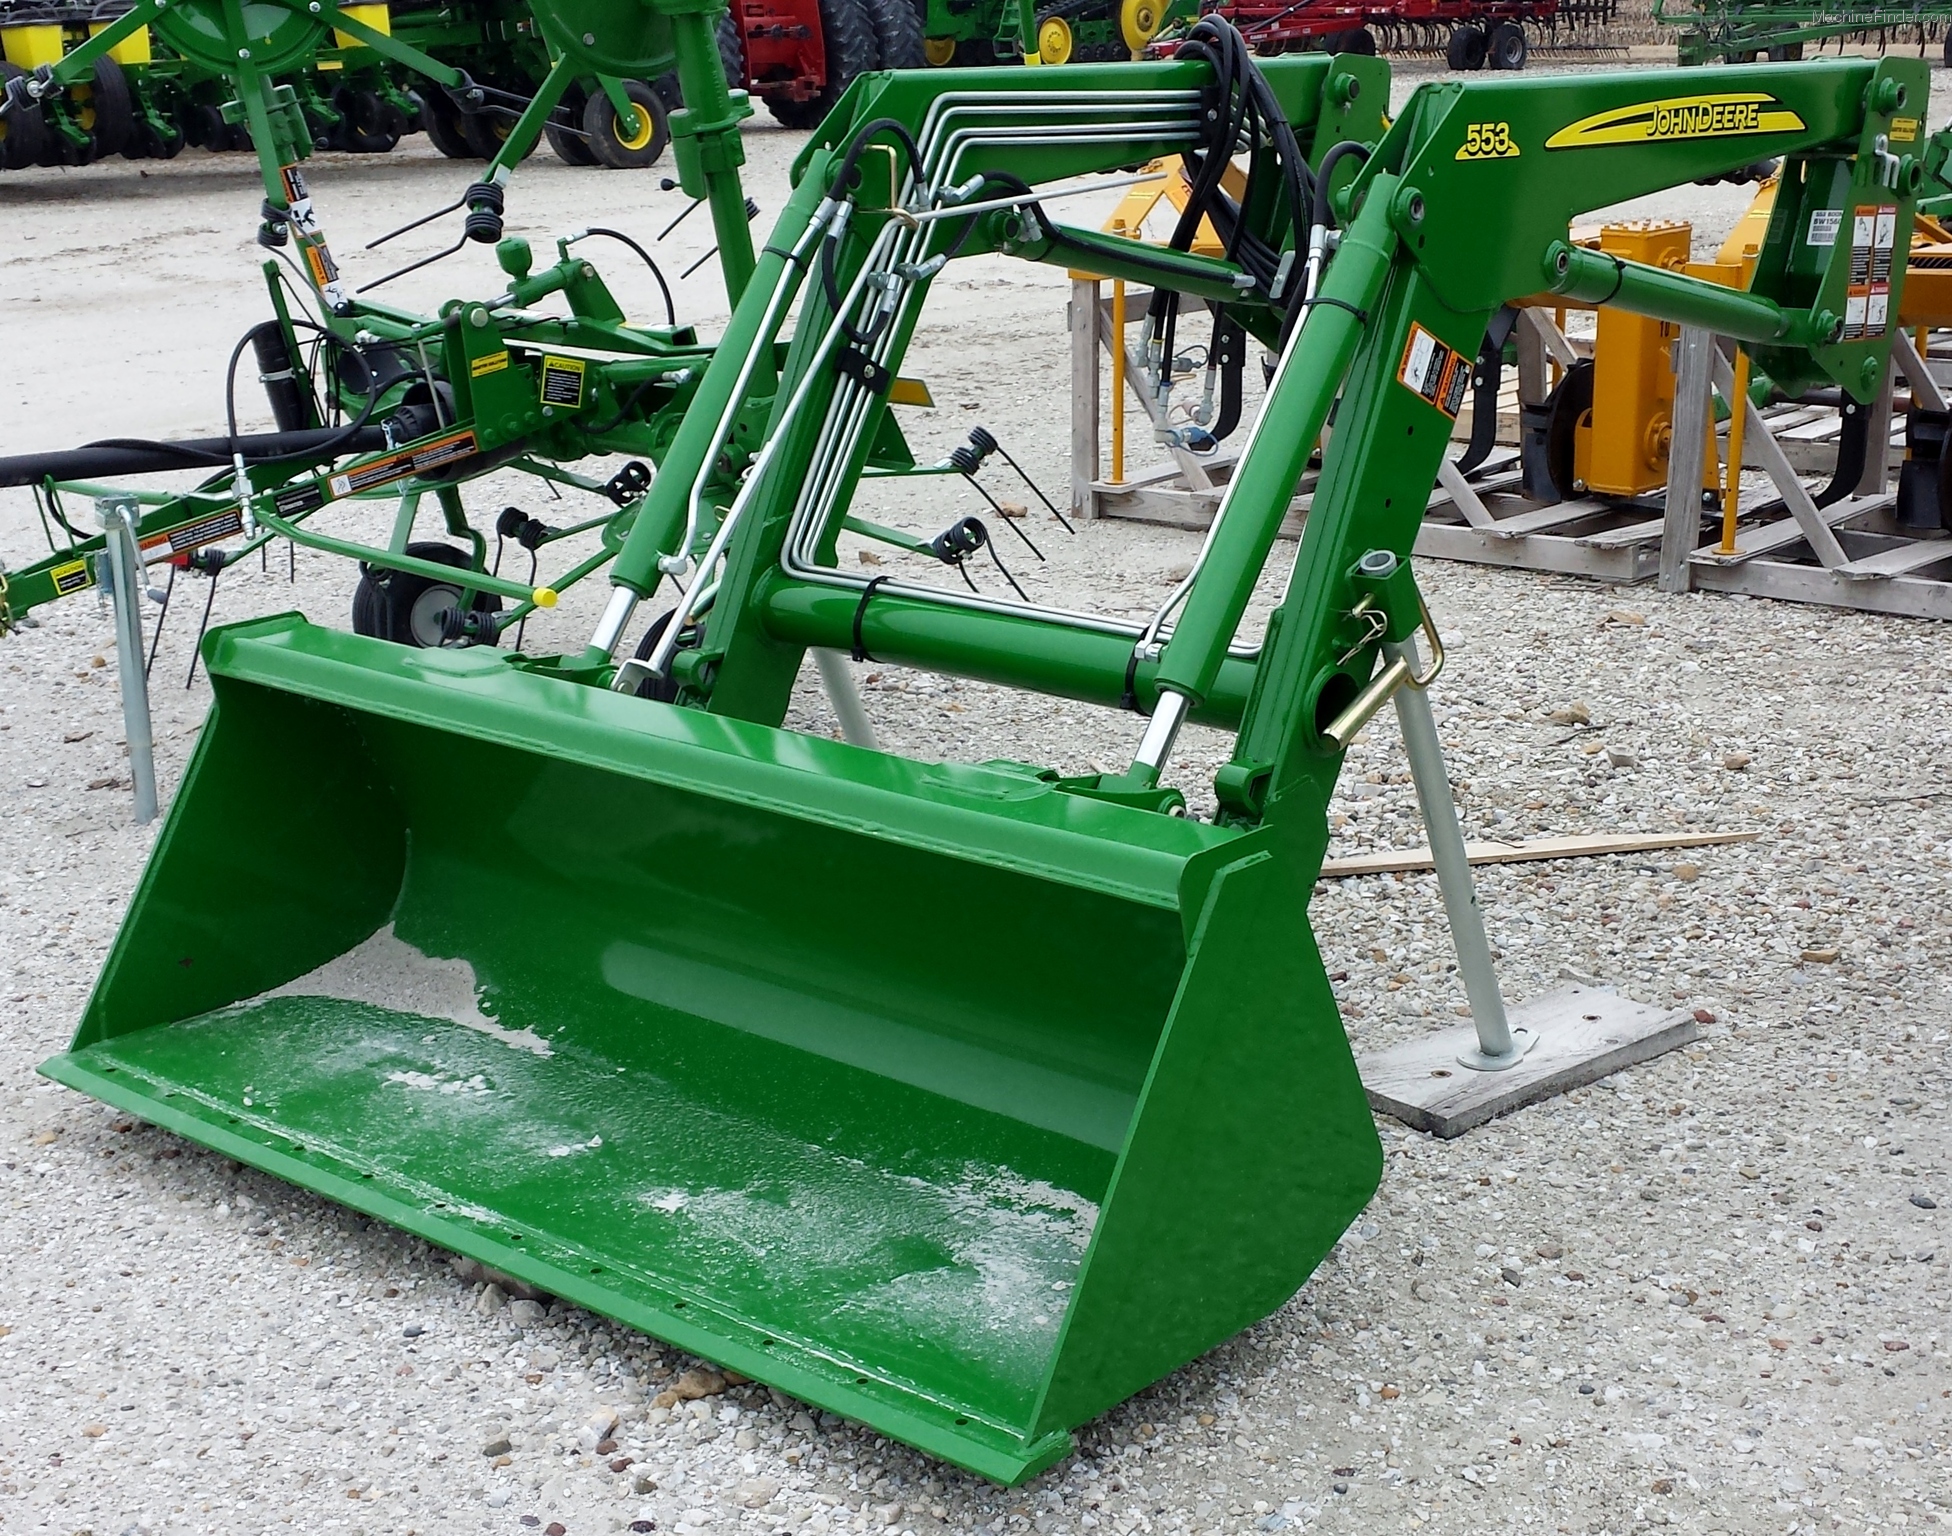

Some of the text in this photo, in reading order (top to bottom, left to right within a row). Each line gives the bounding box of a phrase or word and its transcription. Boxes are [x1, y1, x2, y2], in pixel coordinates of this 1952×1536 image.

[1646, 102, 1759, 136] JOHN DEERE
[1466, 121, 1510, 156] 553
[554, 362, 580, 371] CAUTION
